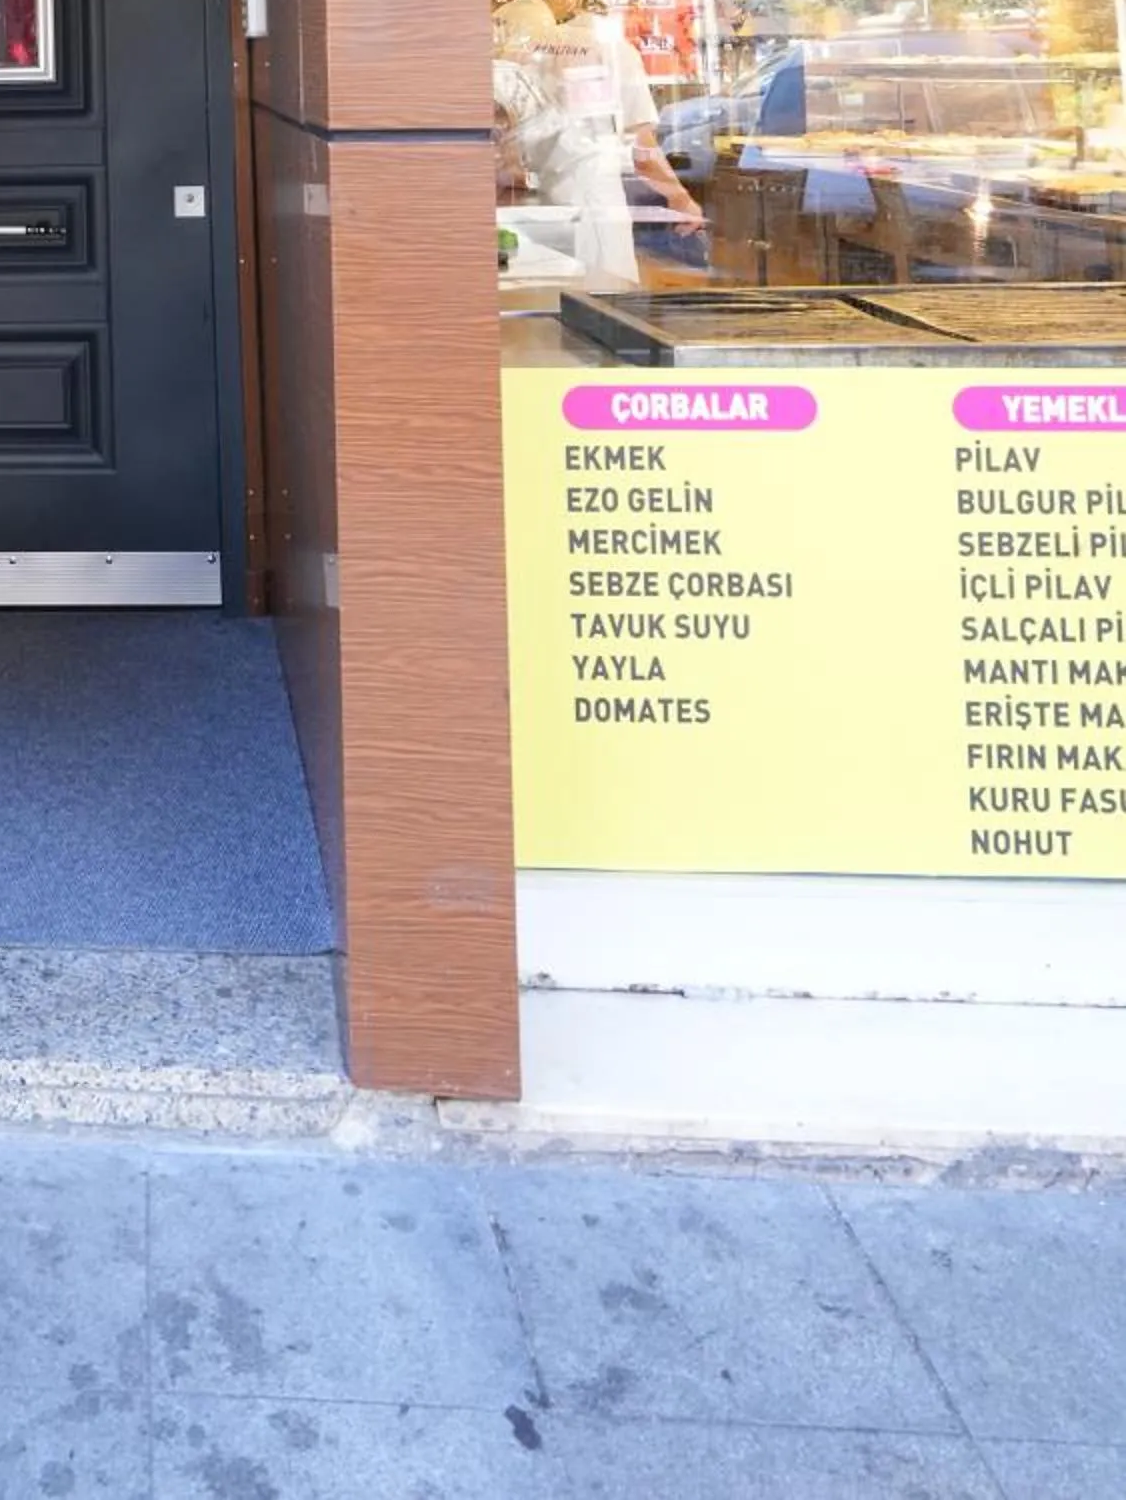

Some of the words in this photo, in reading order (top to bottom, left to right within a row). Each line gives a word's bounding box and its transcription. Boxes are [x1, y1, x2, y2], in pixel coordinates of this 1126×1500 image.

[611, 392, 769, 424] ÇORBALAR
[1002, 394, 1126, 424] YEMEKL
[565, 445, 667, 471] EKMEK
[956, 440, 1040, 473] PİLAV
[566, 487, 619, 513] EZO
[627, 480, 713, 513] GELİN
[957, 489, 1077, 515] BULGUR
[568, 522, 722, 555] MERCİMEK
[958, 525, 1080, 558] SEBZELİ
[569, 571, 659, 597] SEBZE
[668, 571, 793, 602] ÇORBASI
[960, 567, 1015, 603] İÇLİ
[1025, 567, 1112, 600] PİLAV
[570, 613, 667, 639] TAVUK
[674, 613, 750, 640] SUYU
[961, 616, 1086, 645] SALÇALI
[1096, 610, 1123, 643] Pİ
[572, 655, 666, 681] YAYLA
[964, 659, 1058, 685] MANTI
[574, 697, 711, 724] DOMATES
[965, 694, 1070, 731] ERİŞTE
[1080, 702, 1125, 729] MA
[967, 743, 1047, 770] FIRIN
[1057, 745, 1123, 771] MAK
[969, 786, 1051, 813] KURU
[971, 829, 1073, 856] NOHUT
